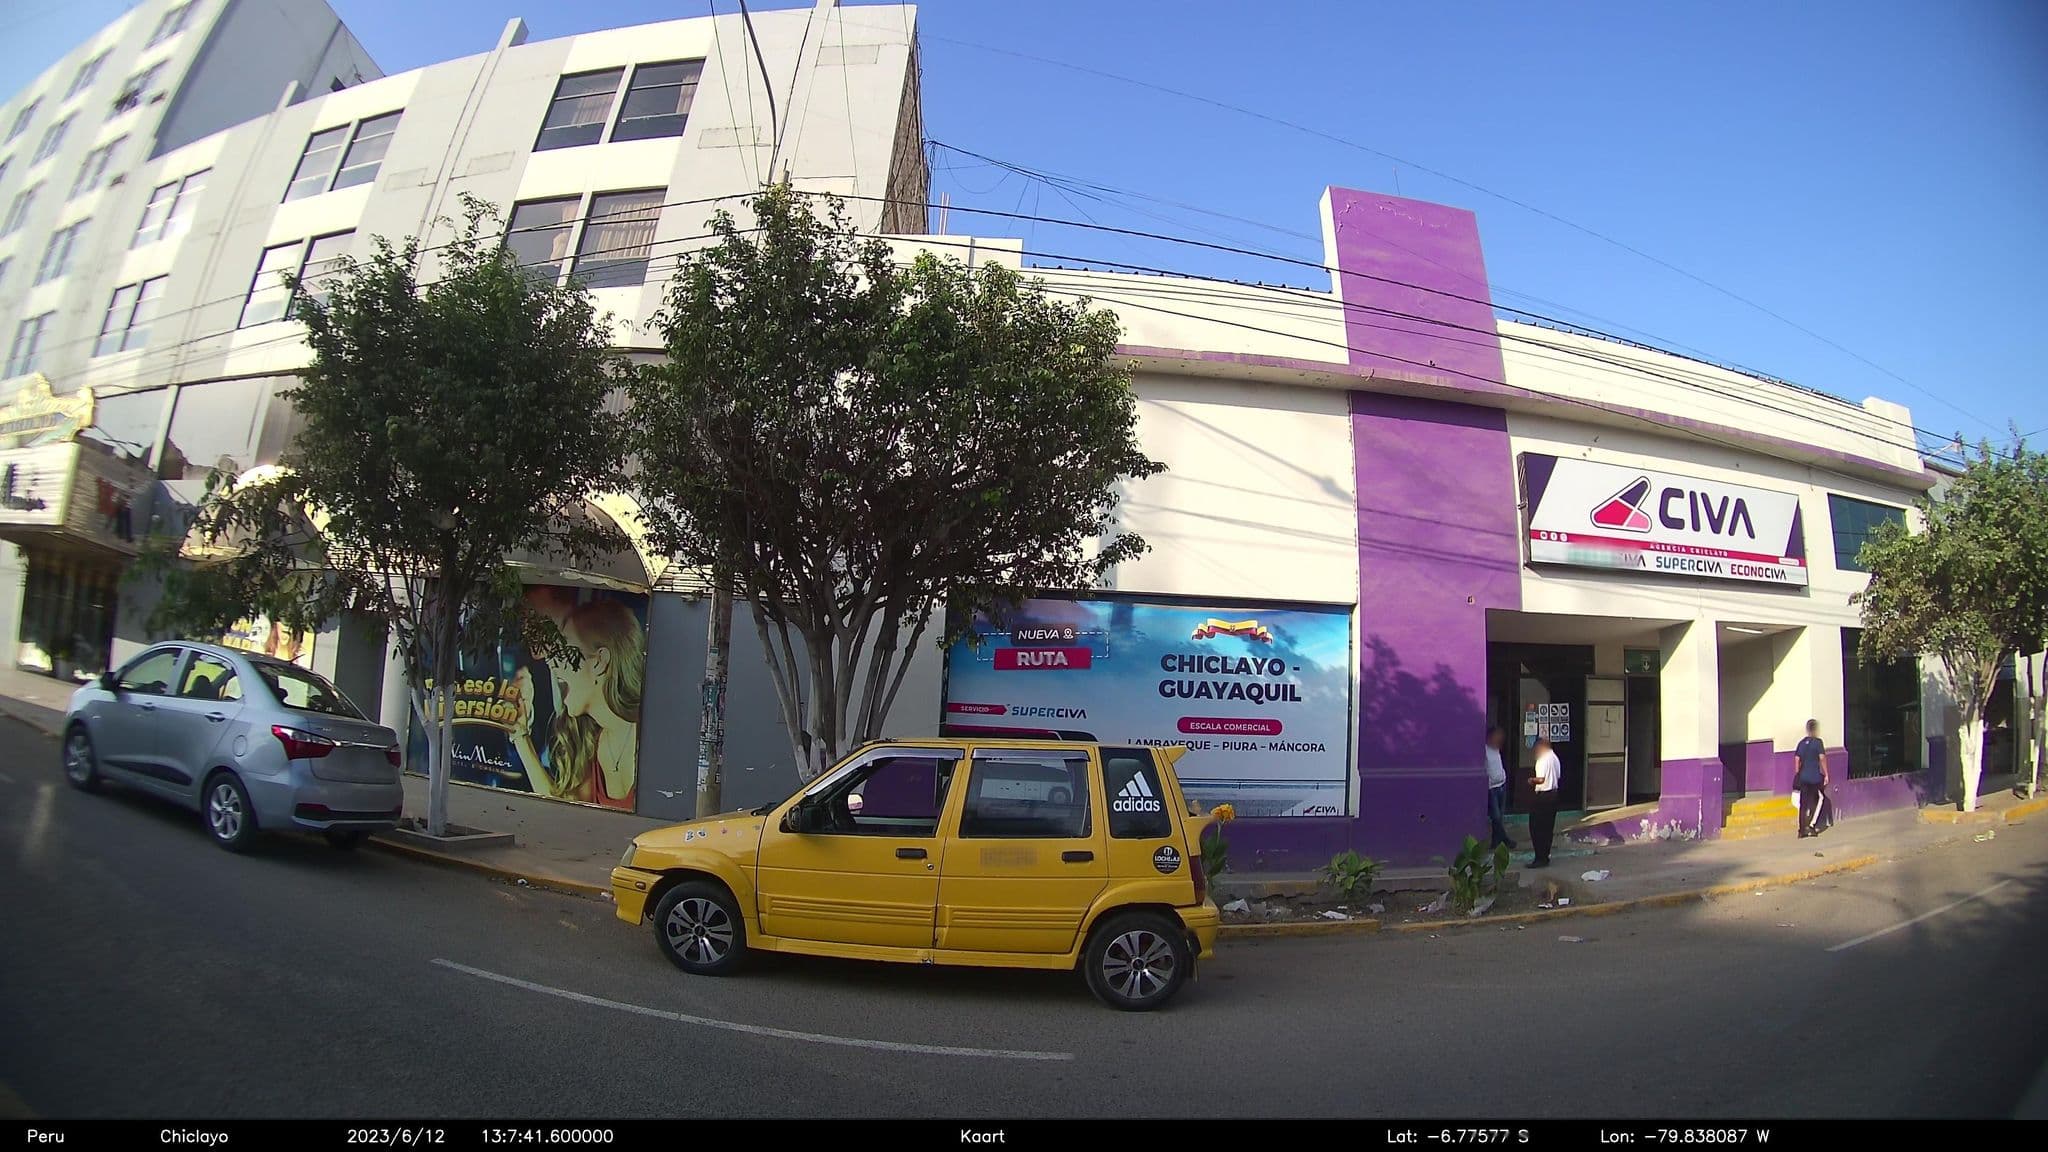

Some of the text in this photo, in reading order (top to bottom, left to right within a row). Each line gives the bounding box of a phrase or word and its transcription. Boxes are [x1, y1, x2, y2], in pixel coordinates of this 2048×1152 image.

[1658, 487, 1756, 539] CIVA
[1649, 543, 1687, 554] AGENCIA
[1655, 556, 1723, 575] SUPERCIVA
[1730, 563, 1787, 580] ECONOCIVA
[1018, 629, 1060, 641] NUEVA
[1016, 651, 1069, 667] RUTA
[1160, 653, 1286, 677] CHICLAYO
[498, 678, 521, 700] la
[1158, 679, 1302, 705] GUAYAQUIL
[423, 697, 519, 723] iersión
[960, 705, 990, 713] SERVICIO
[1011, 706, 1088, 719] SUPERCIVA
[1189, 722, 1271, 732] ESCALA COMERCIAL
[1222, 741, 1258, 751] PIURA
[1268, 740, 1326, 753] MÁNCORA
[1113, 796, 1161, 812] adidas
